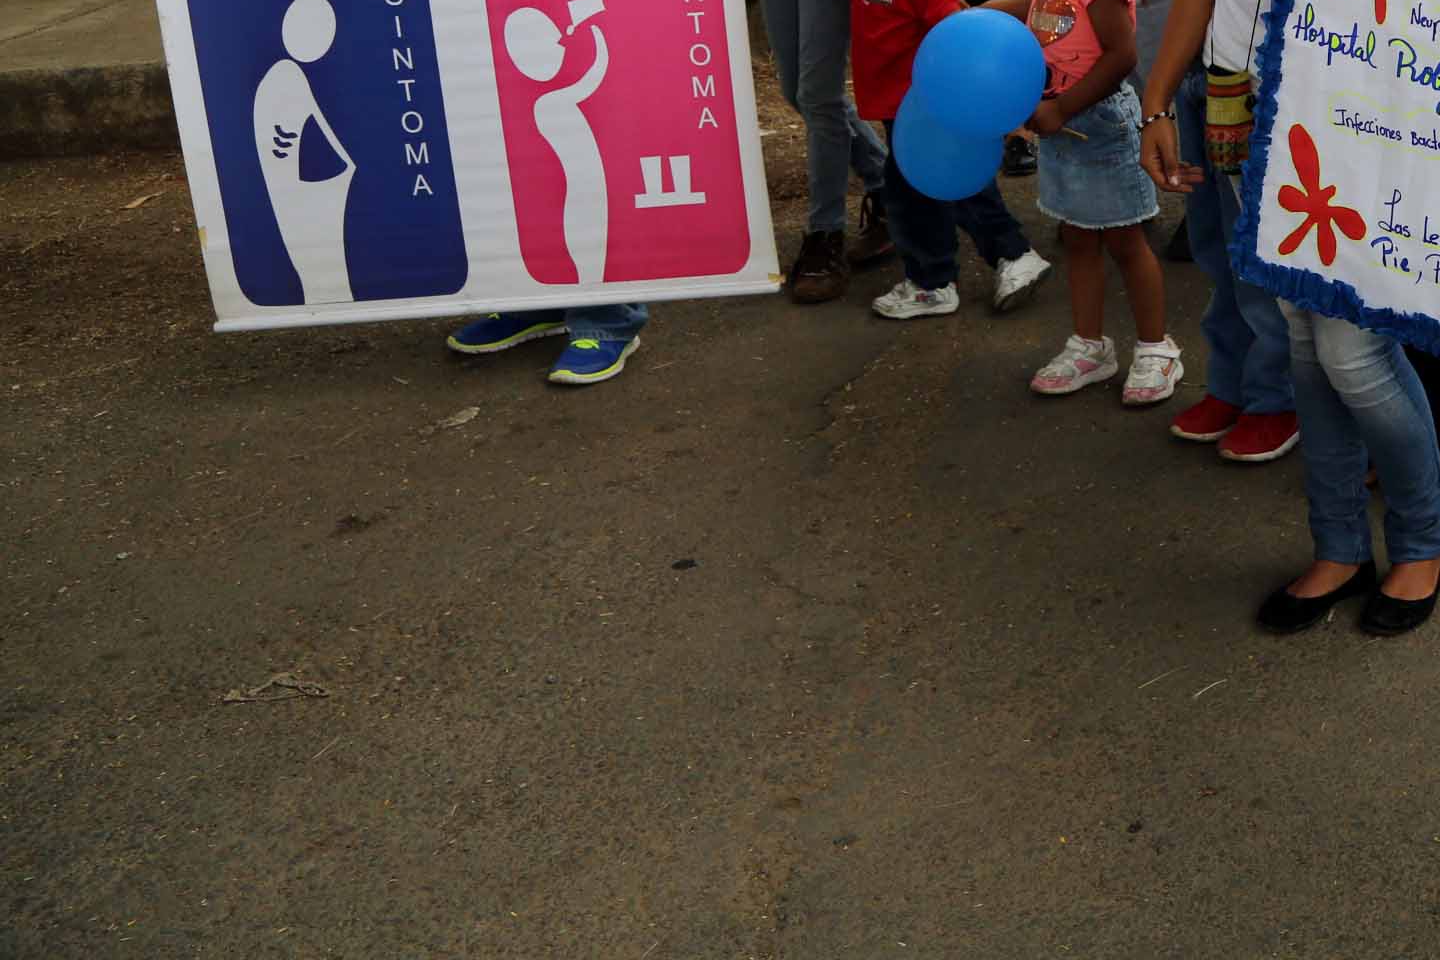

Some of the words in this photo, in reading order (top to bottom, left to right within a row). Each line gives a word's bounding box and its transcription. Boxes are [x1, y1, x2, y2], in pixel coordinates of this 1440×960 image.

[1292, 2, 1377, 69] Hospital
[1334, 109, 1402, 142] Infecciones
[1378, 189, 1411, 238] Las
